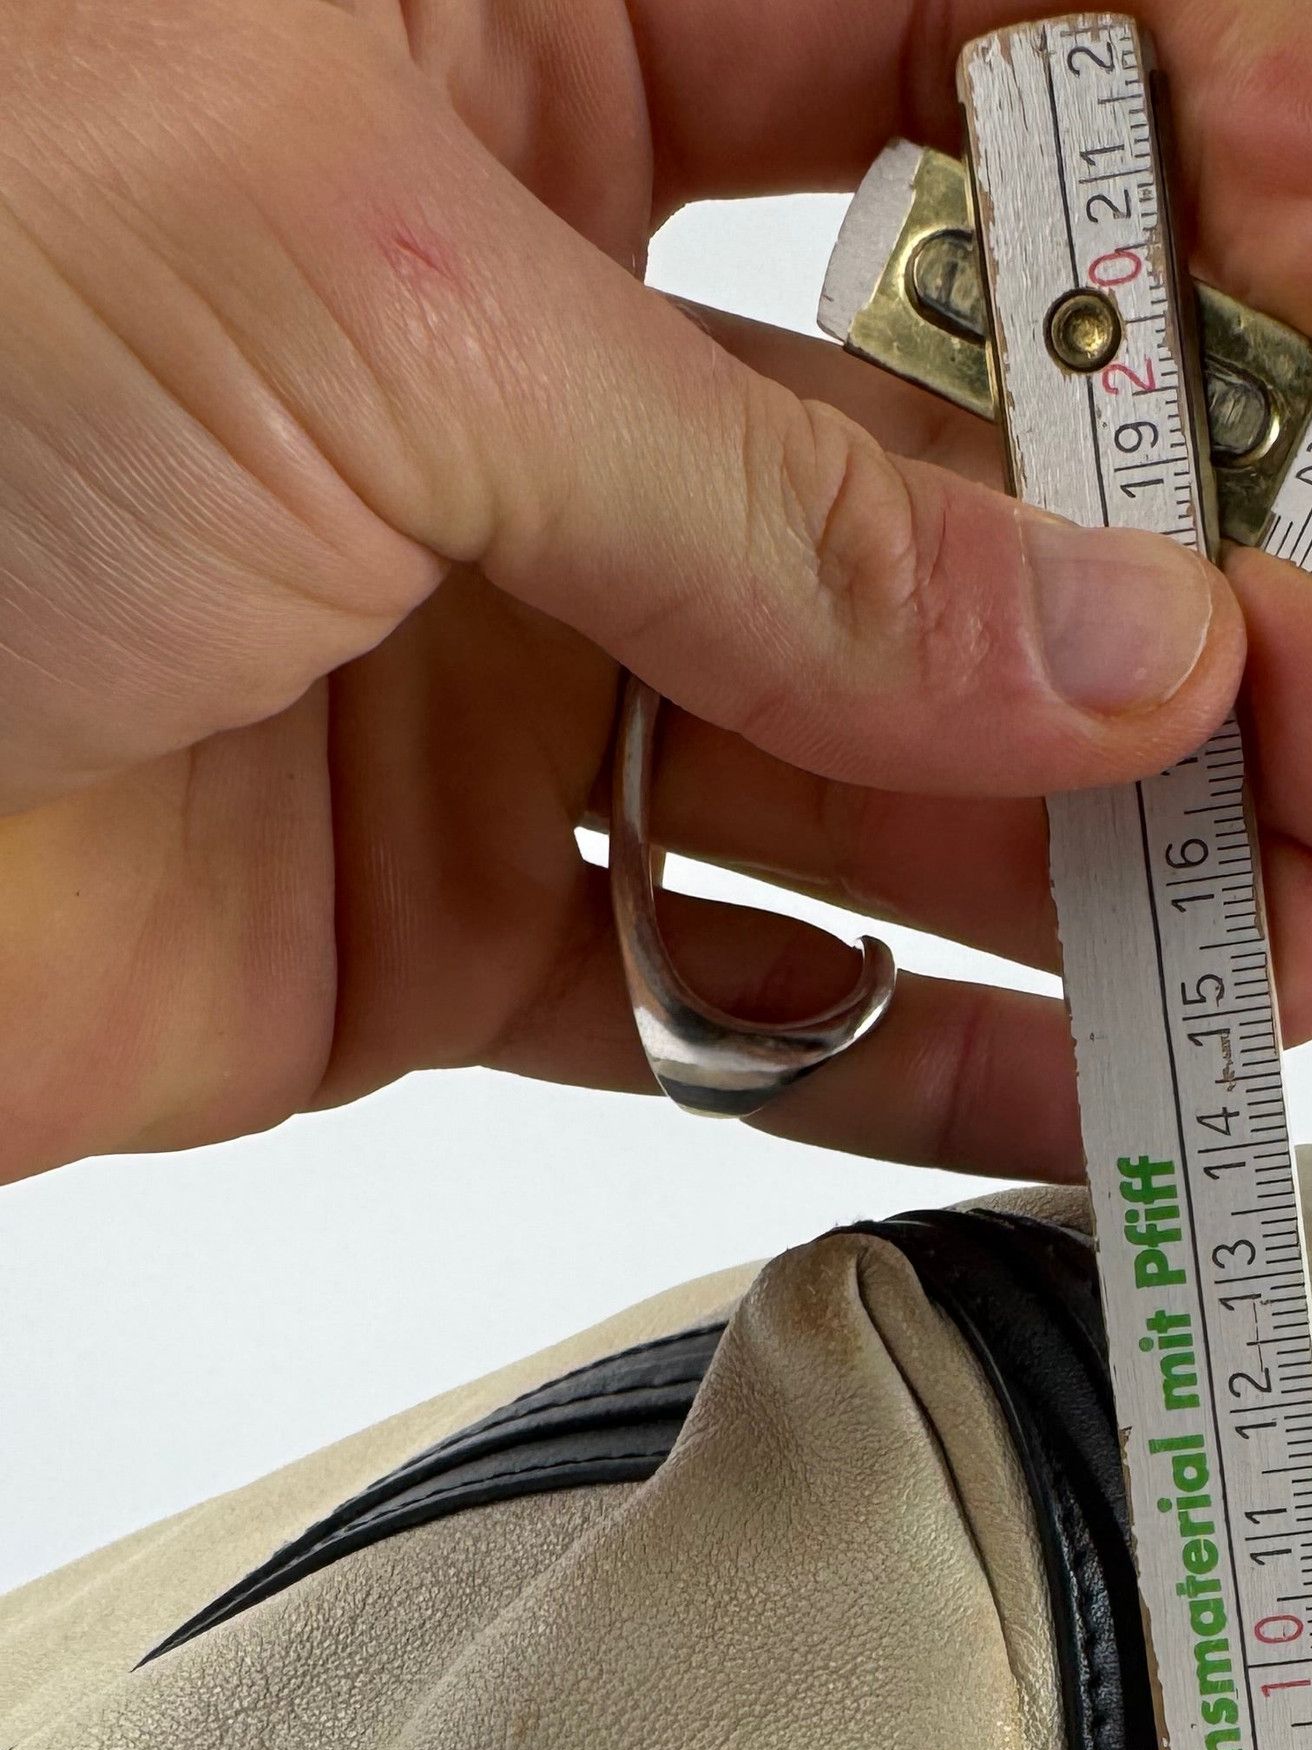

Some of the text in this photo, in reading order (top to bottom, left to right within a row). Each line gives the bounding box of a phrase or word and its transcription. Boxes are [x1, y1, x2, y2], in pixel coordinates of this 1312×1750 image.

[1079, 143, 1132, 223] 21
[1088, 248, 1156, 396] 20
[1114, 419, 1164, 498] 19
[1165, 837, 1215, 912] 16
[1181, 972, 1230, 1047] 15
[1196, 1105, 1246, 1180] 14
[1116, 1154, 1187, 1289] Pfiff
[1211, 1239, 1262, 1312] 13
[1138, 1309, 1201, 1411] mit
[1228, 1367, 1277, 1440] 12
[1245, 1508, 1292, 1565] 11
[1253, 1614, 1311, 1697] 10
